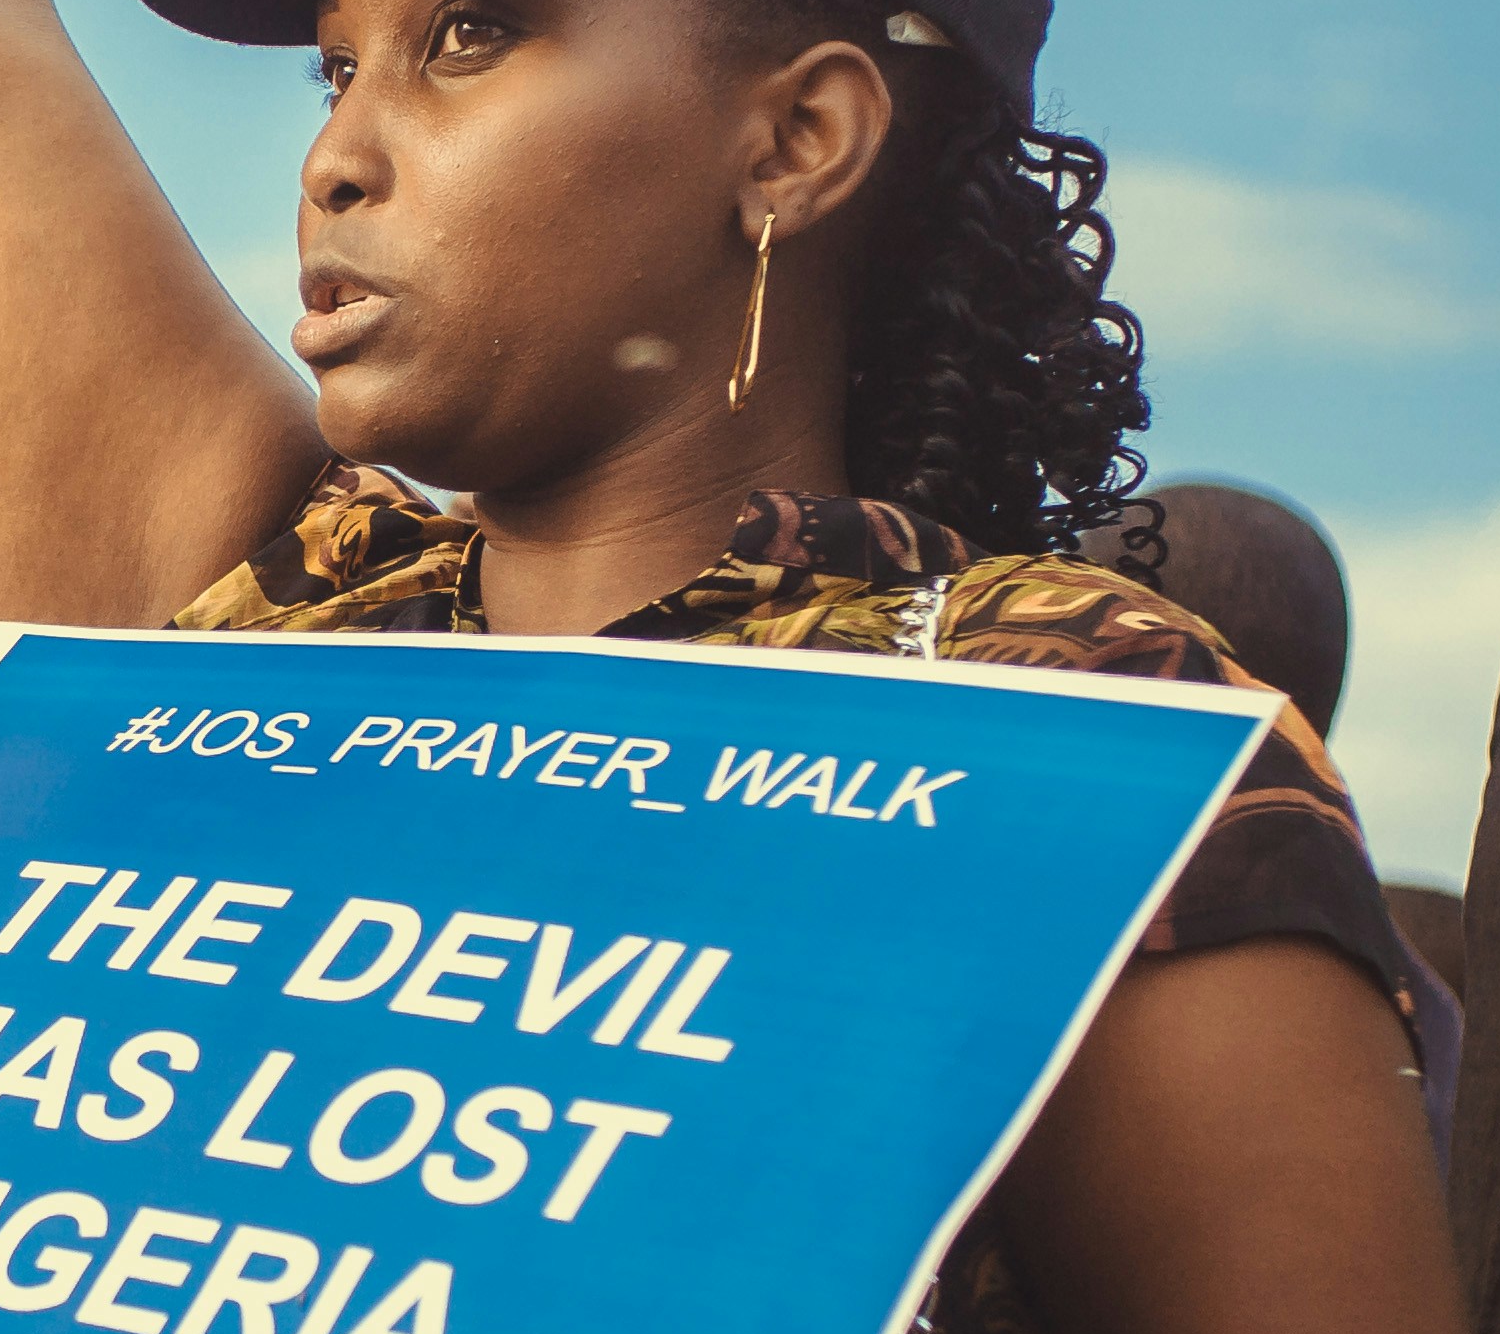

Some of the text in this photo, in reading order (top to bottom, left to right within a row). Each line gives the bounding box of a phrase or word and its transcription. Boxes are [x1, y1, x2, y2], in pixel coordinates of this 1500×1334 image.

[107, 707, 967, 827] #JOS_PRAYER_WALK
[283, 898, 734, 1062] DEVIL
[204, 1051, 672, 1222] LOST
